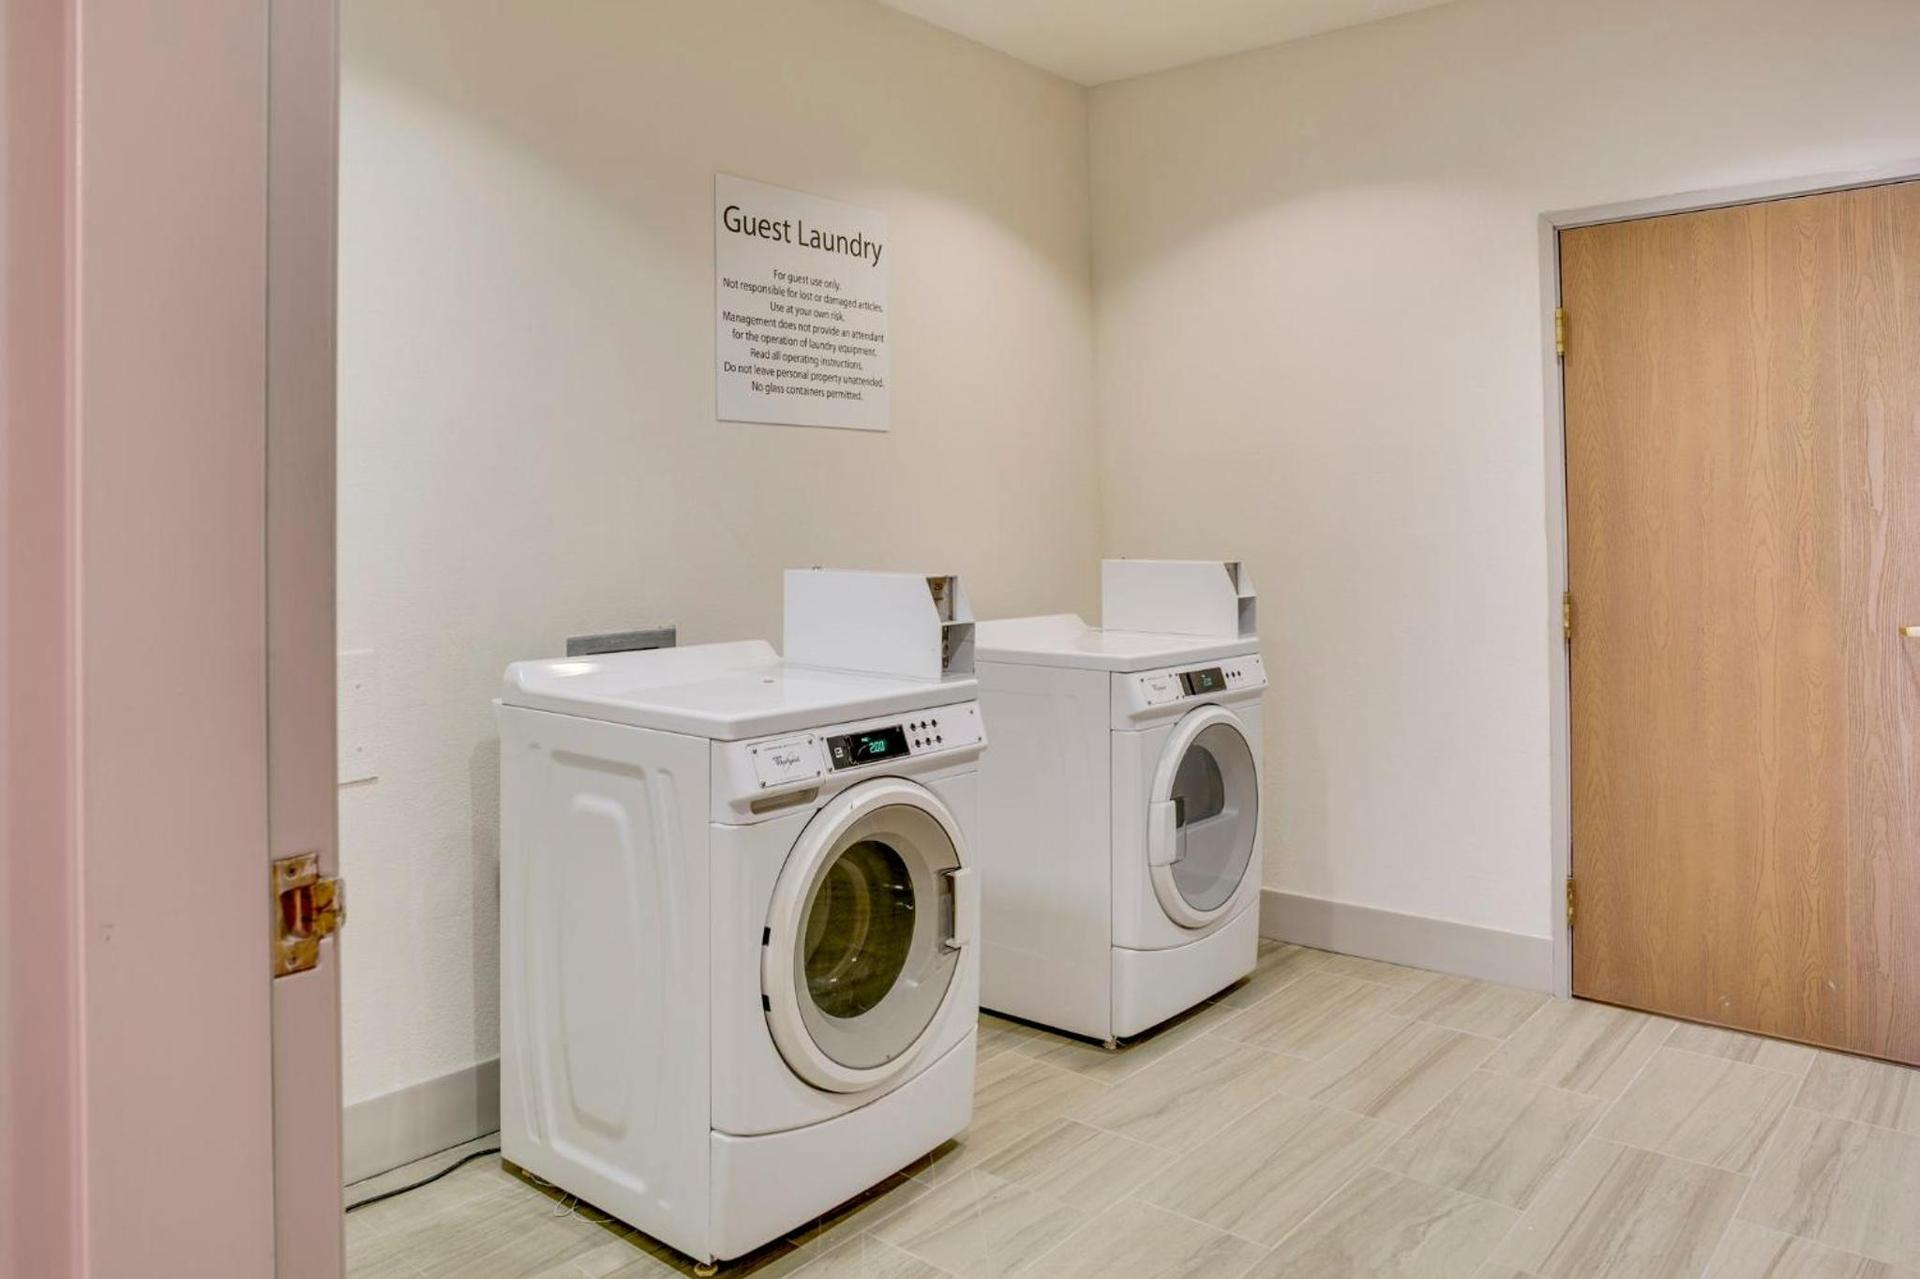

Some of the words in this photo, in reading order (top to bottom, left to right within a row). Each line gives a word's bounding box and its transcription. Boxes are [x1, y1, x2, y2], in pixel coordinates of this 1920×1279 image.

[723, 205, 791, 243] Guest
[798, 220, 882, 267] Laundry
[774, 269, 786, 280] For
[787, 274, 808, 284] guest
[810, 278, 822, 287] use
[824, 279, 841, 292] only.
[723, 278, 738, 288] Not
[740, 283, 785, 297] responsible
[787, 288, 798, 298] for
[799, 291, 812, 300] lost
[814, 294, 823, 302] or
[824, 295, 856, 309] damaged
[858, 301, 883, 312] articles.
[770, 302, 784, 313] Use
[786, 306, 793, 314] at
[795, 307, 812, 317] your
[813, 309, 829, 318] own
[831, 311, 845, 321] risk.
[723, 311, 776, 326] Management
[778, 320, 796, 330] does
[798, 324, 811, 332] not
[812, 325, 840, 337] provide
[841, 329, 850, 337] an
[851, 330, 883, 342] attendant
[732, 329, 744, 339] for
[746, 331, 759, 342] the
[760, 335, 798, 346] operation
[800, 337, 808, 347] of
[809, 339, 836, 353] laundry
[838, 345, 877, 356] equipment.
[750, 348, 770, 359] Read
[772, 351, 781, 360] all
[783, 353, 819, 367] operating
[821, 358, 863, 370] instructions.
[723, 362, 736, 372] Do
[738, 365, 752, 374] not
[754, 364, 775, 376] leave
[777, 370, 809, 379] personal
[811, 373, 841, 385] property
[843, 376, 884, 387] unattended.
[752, 381, 763, 392] No
[765, 383, 784, 394] glass
[786, 387, 825, 397] containers
[827, 389, 863, 400] permitted.
